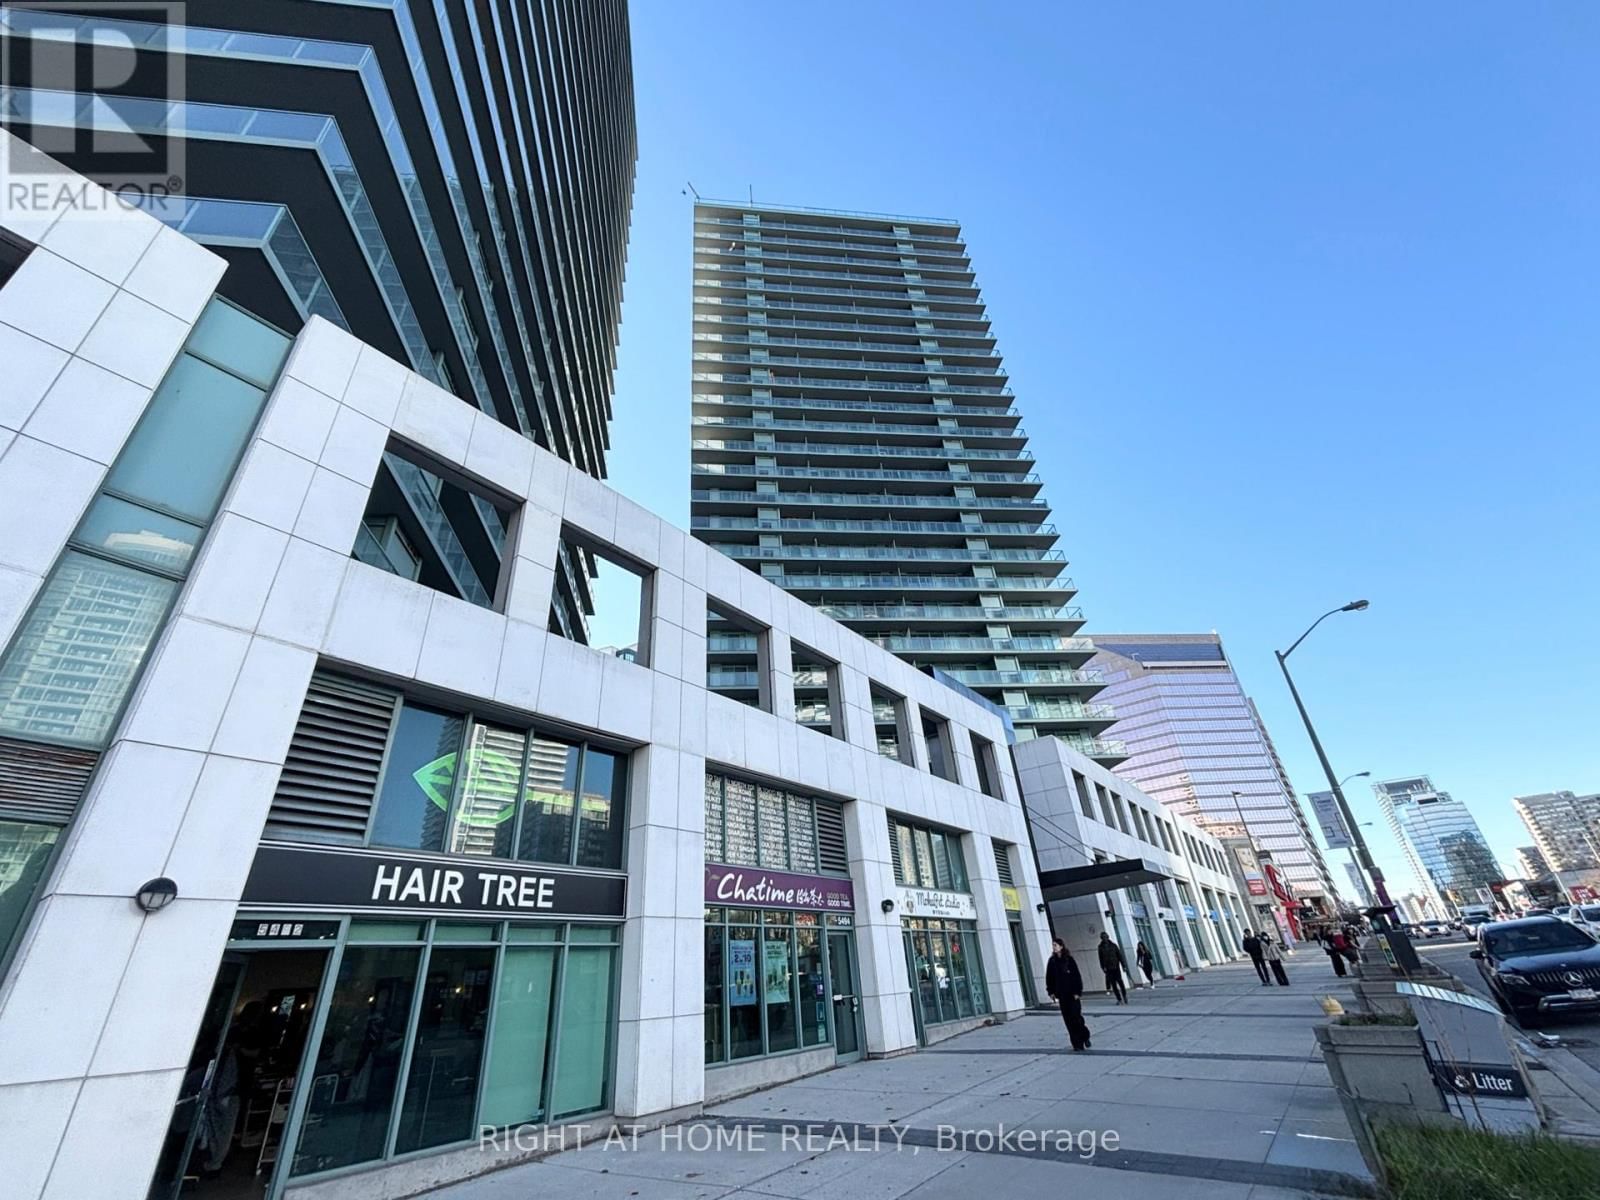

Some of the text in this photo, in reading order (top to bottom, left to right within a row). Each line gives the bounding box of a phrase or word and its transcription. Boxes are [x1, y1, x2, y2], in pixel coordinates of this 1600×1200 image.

[371, 865, 555, 908] HAIR TREE
[717, 873, 794, 903] Chatime
[827, 899, 840, 907] GOOD
[837, 916, 851, 925] 5494
[1472, 1072, 1513, 1092] Litter
